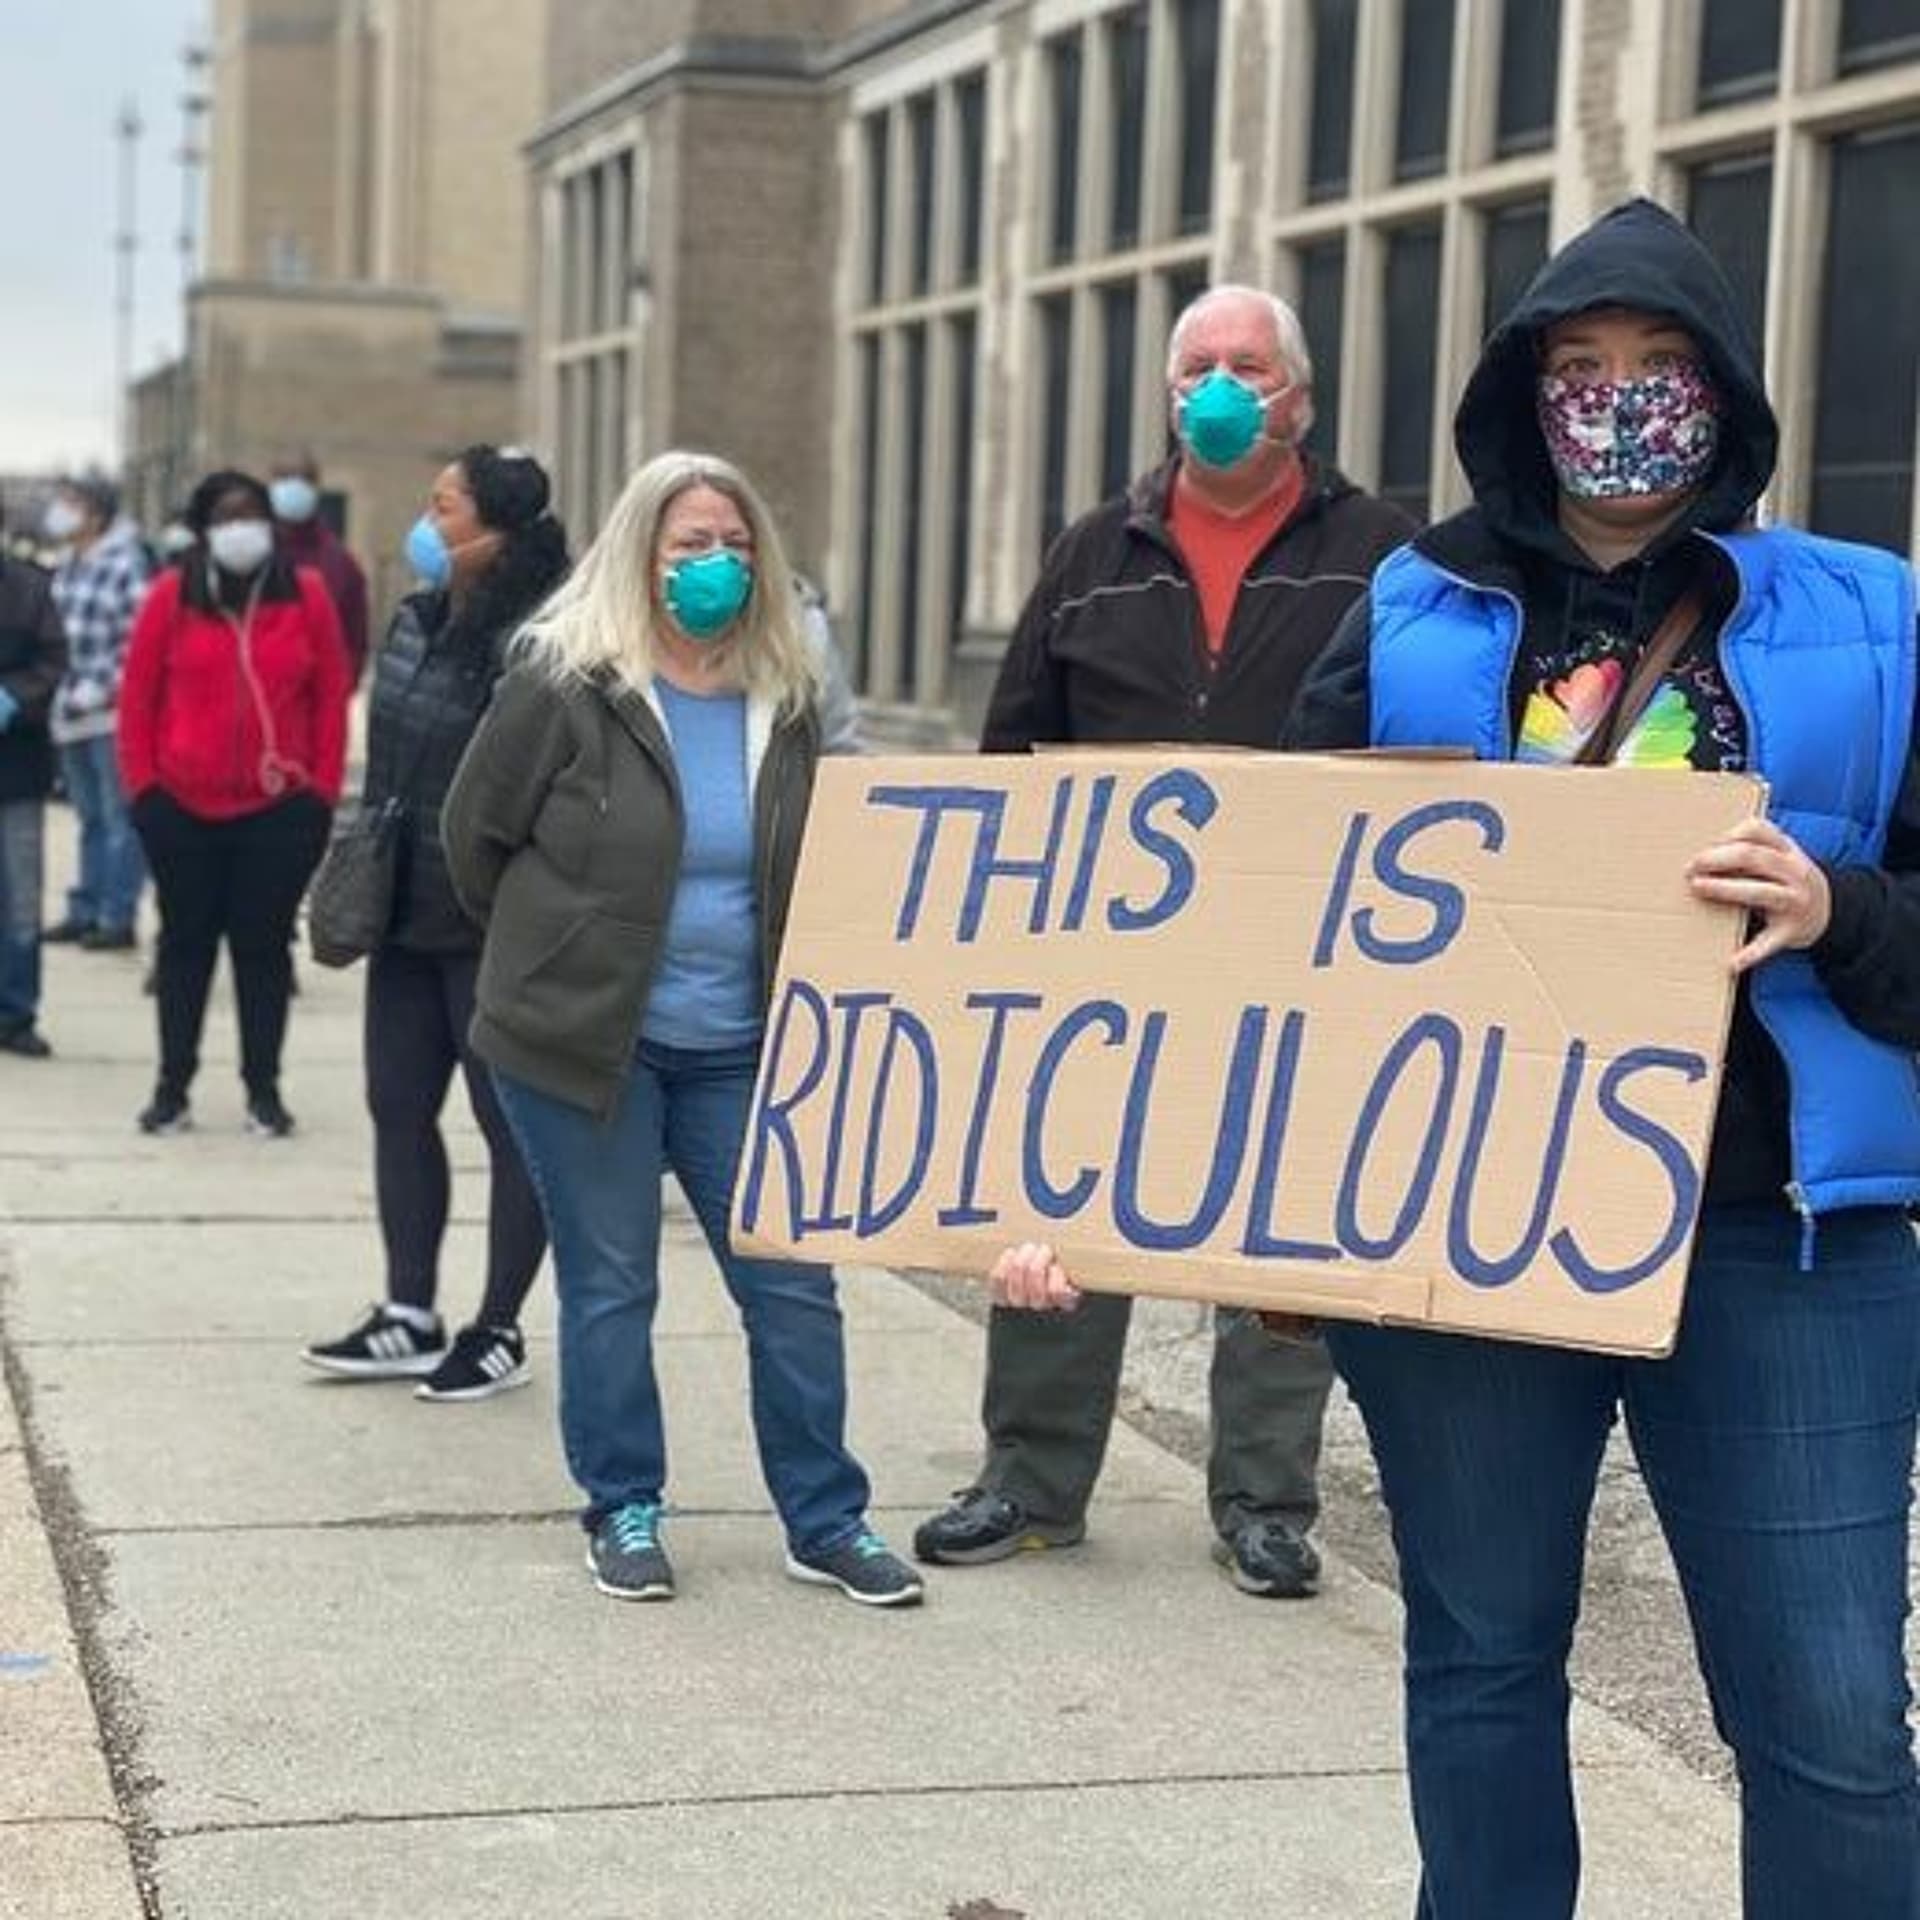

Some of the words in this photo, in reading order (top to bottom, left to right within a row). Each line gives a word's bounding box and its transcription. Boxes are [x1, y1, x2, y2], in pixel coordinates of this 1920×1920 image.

[866, 766, 1220, 943] THIS
[1312, 799, 1506, 968] IS
[740, 979, 1709, 1293] RIDICULOUS
